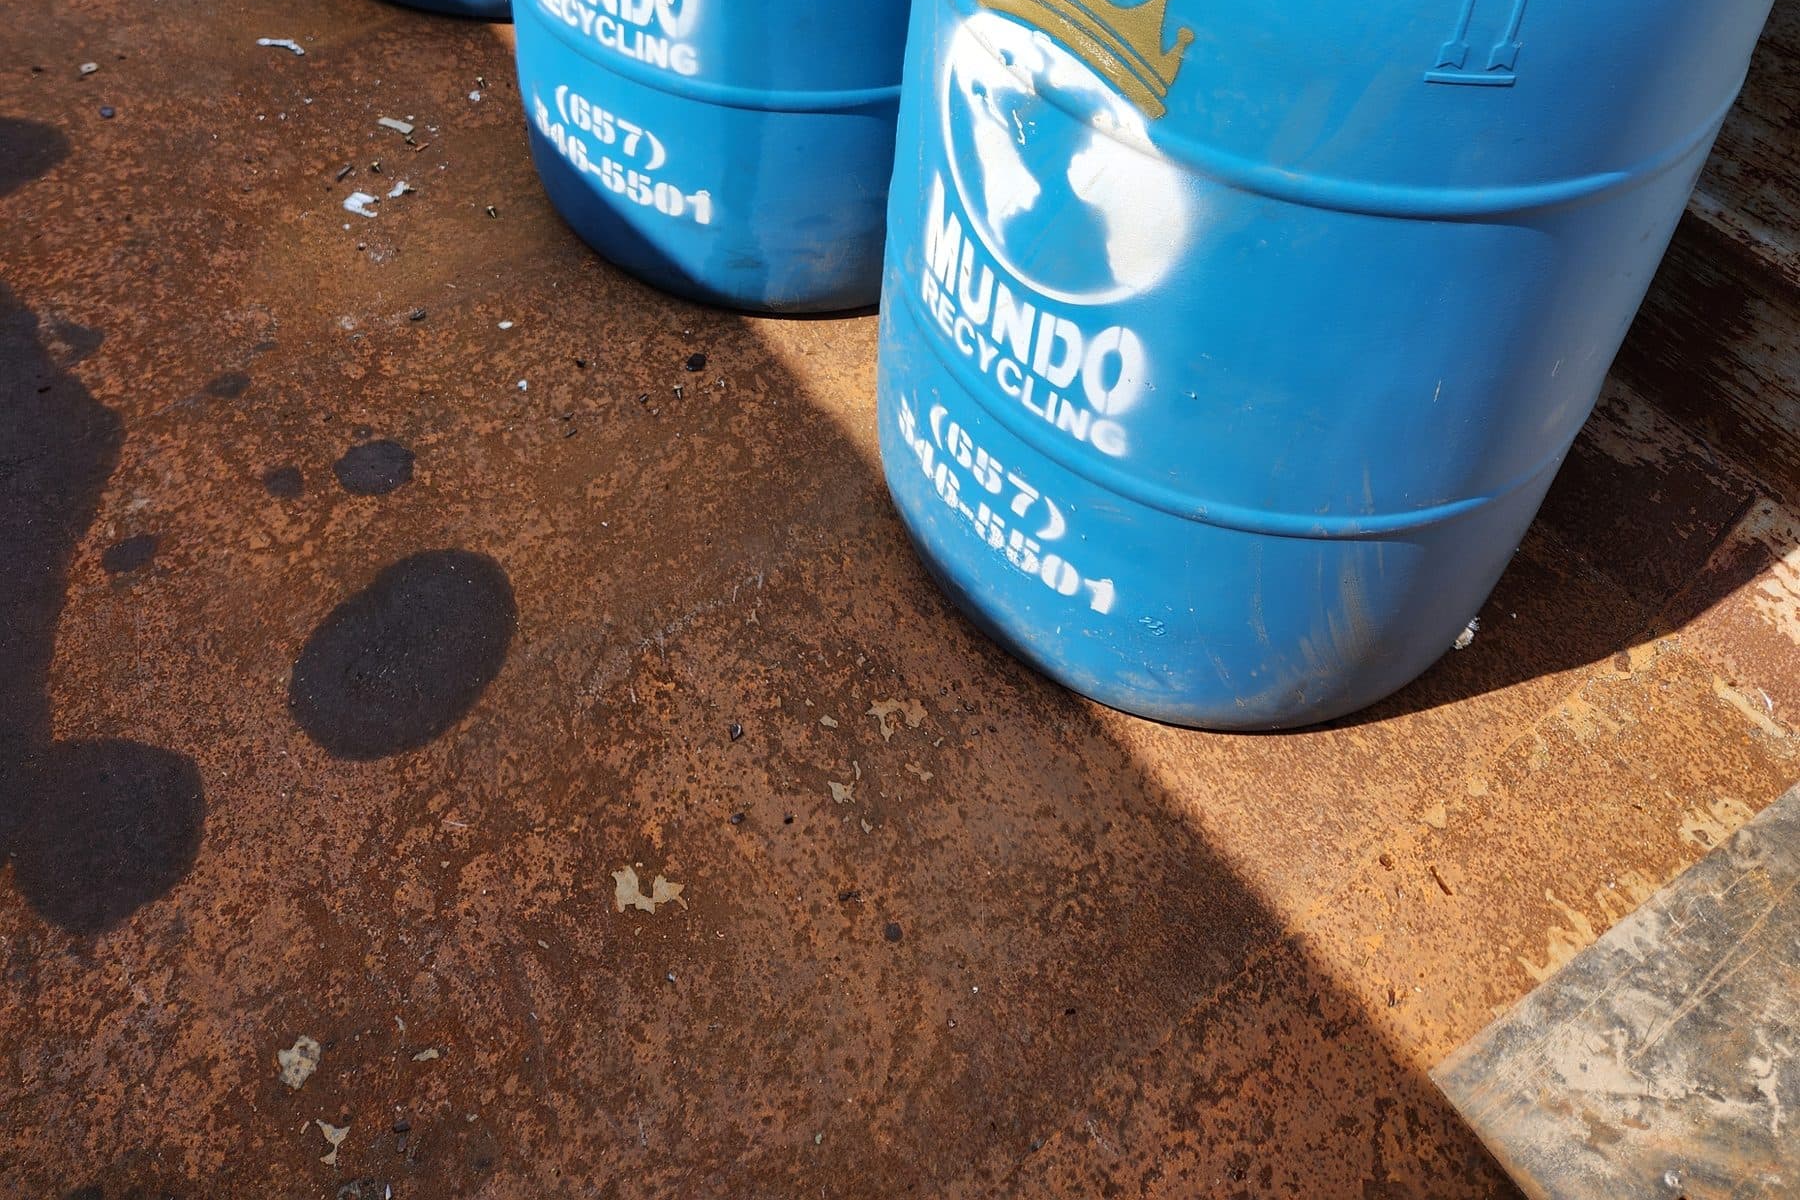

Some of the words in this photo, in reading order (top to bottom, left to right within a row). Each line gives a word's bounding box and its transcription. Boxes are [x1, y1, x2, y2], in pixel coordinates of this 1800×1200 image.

[555, 84, 666, 170] (657)
[922, 274, 1129, 457] RECYCLING
[924, 171, 1144, 416] MUNDO
[929, 405, 1065, 541] (657)
